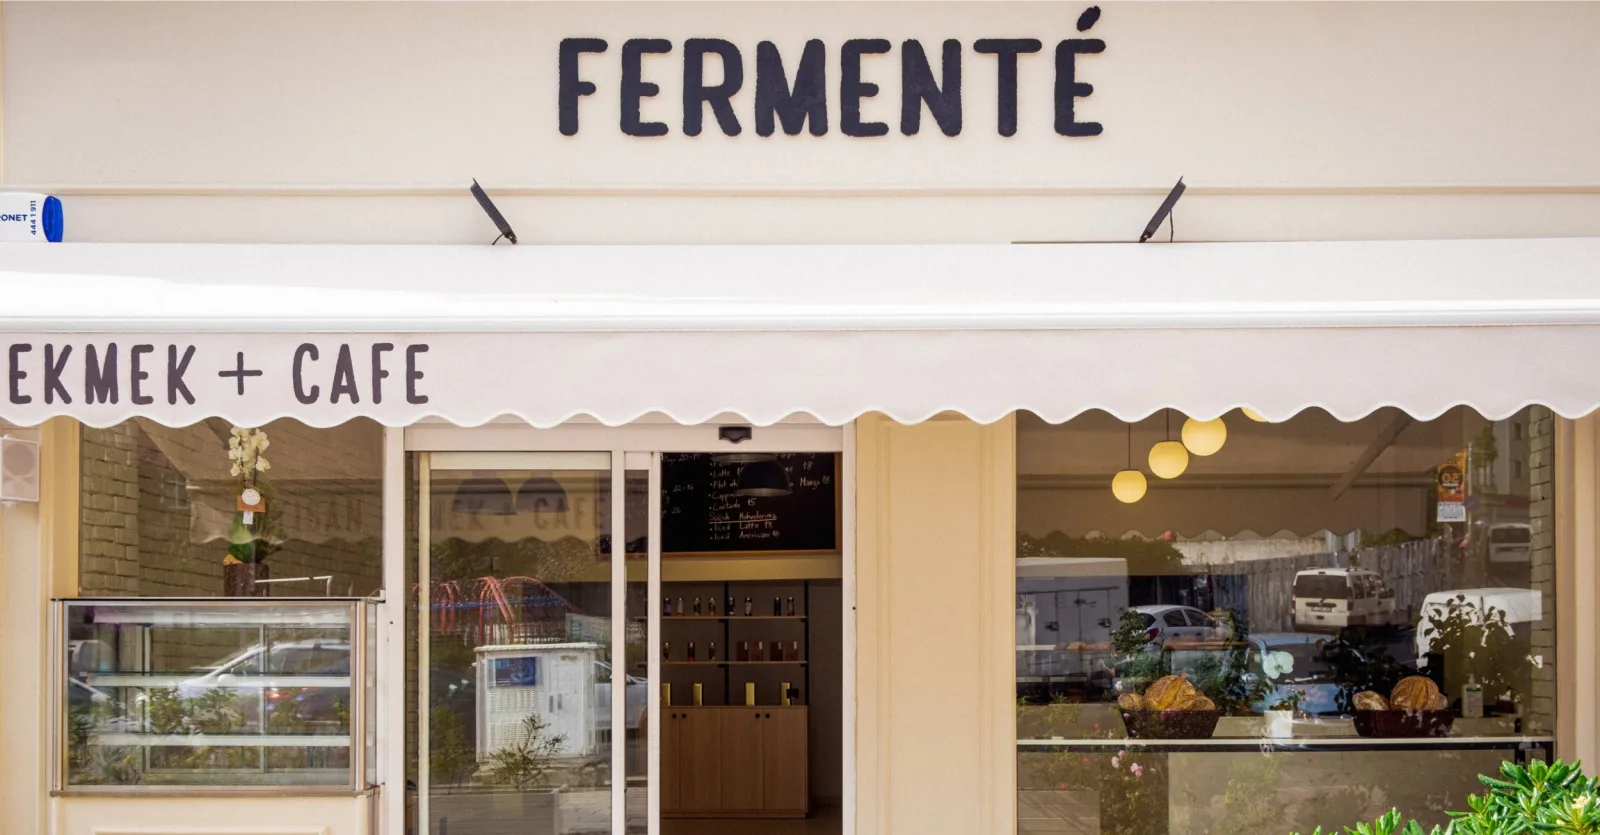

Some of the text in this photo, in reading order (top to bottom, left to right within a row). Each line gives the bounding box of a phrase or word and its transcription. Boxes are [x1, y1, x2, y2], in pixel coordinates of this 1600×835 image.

[558, 6, 1106, 136] FERMENTÉ
[0, 214, 28, 222] ONET
[9, 343, 196, 405] EKMEK
[292, 343, 430, 405] CAFE
